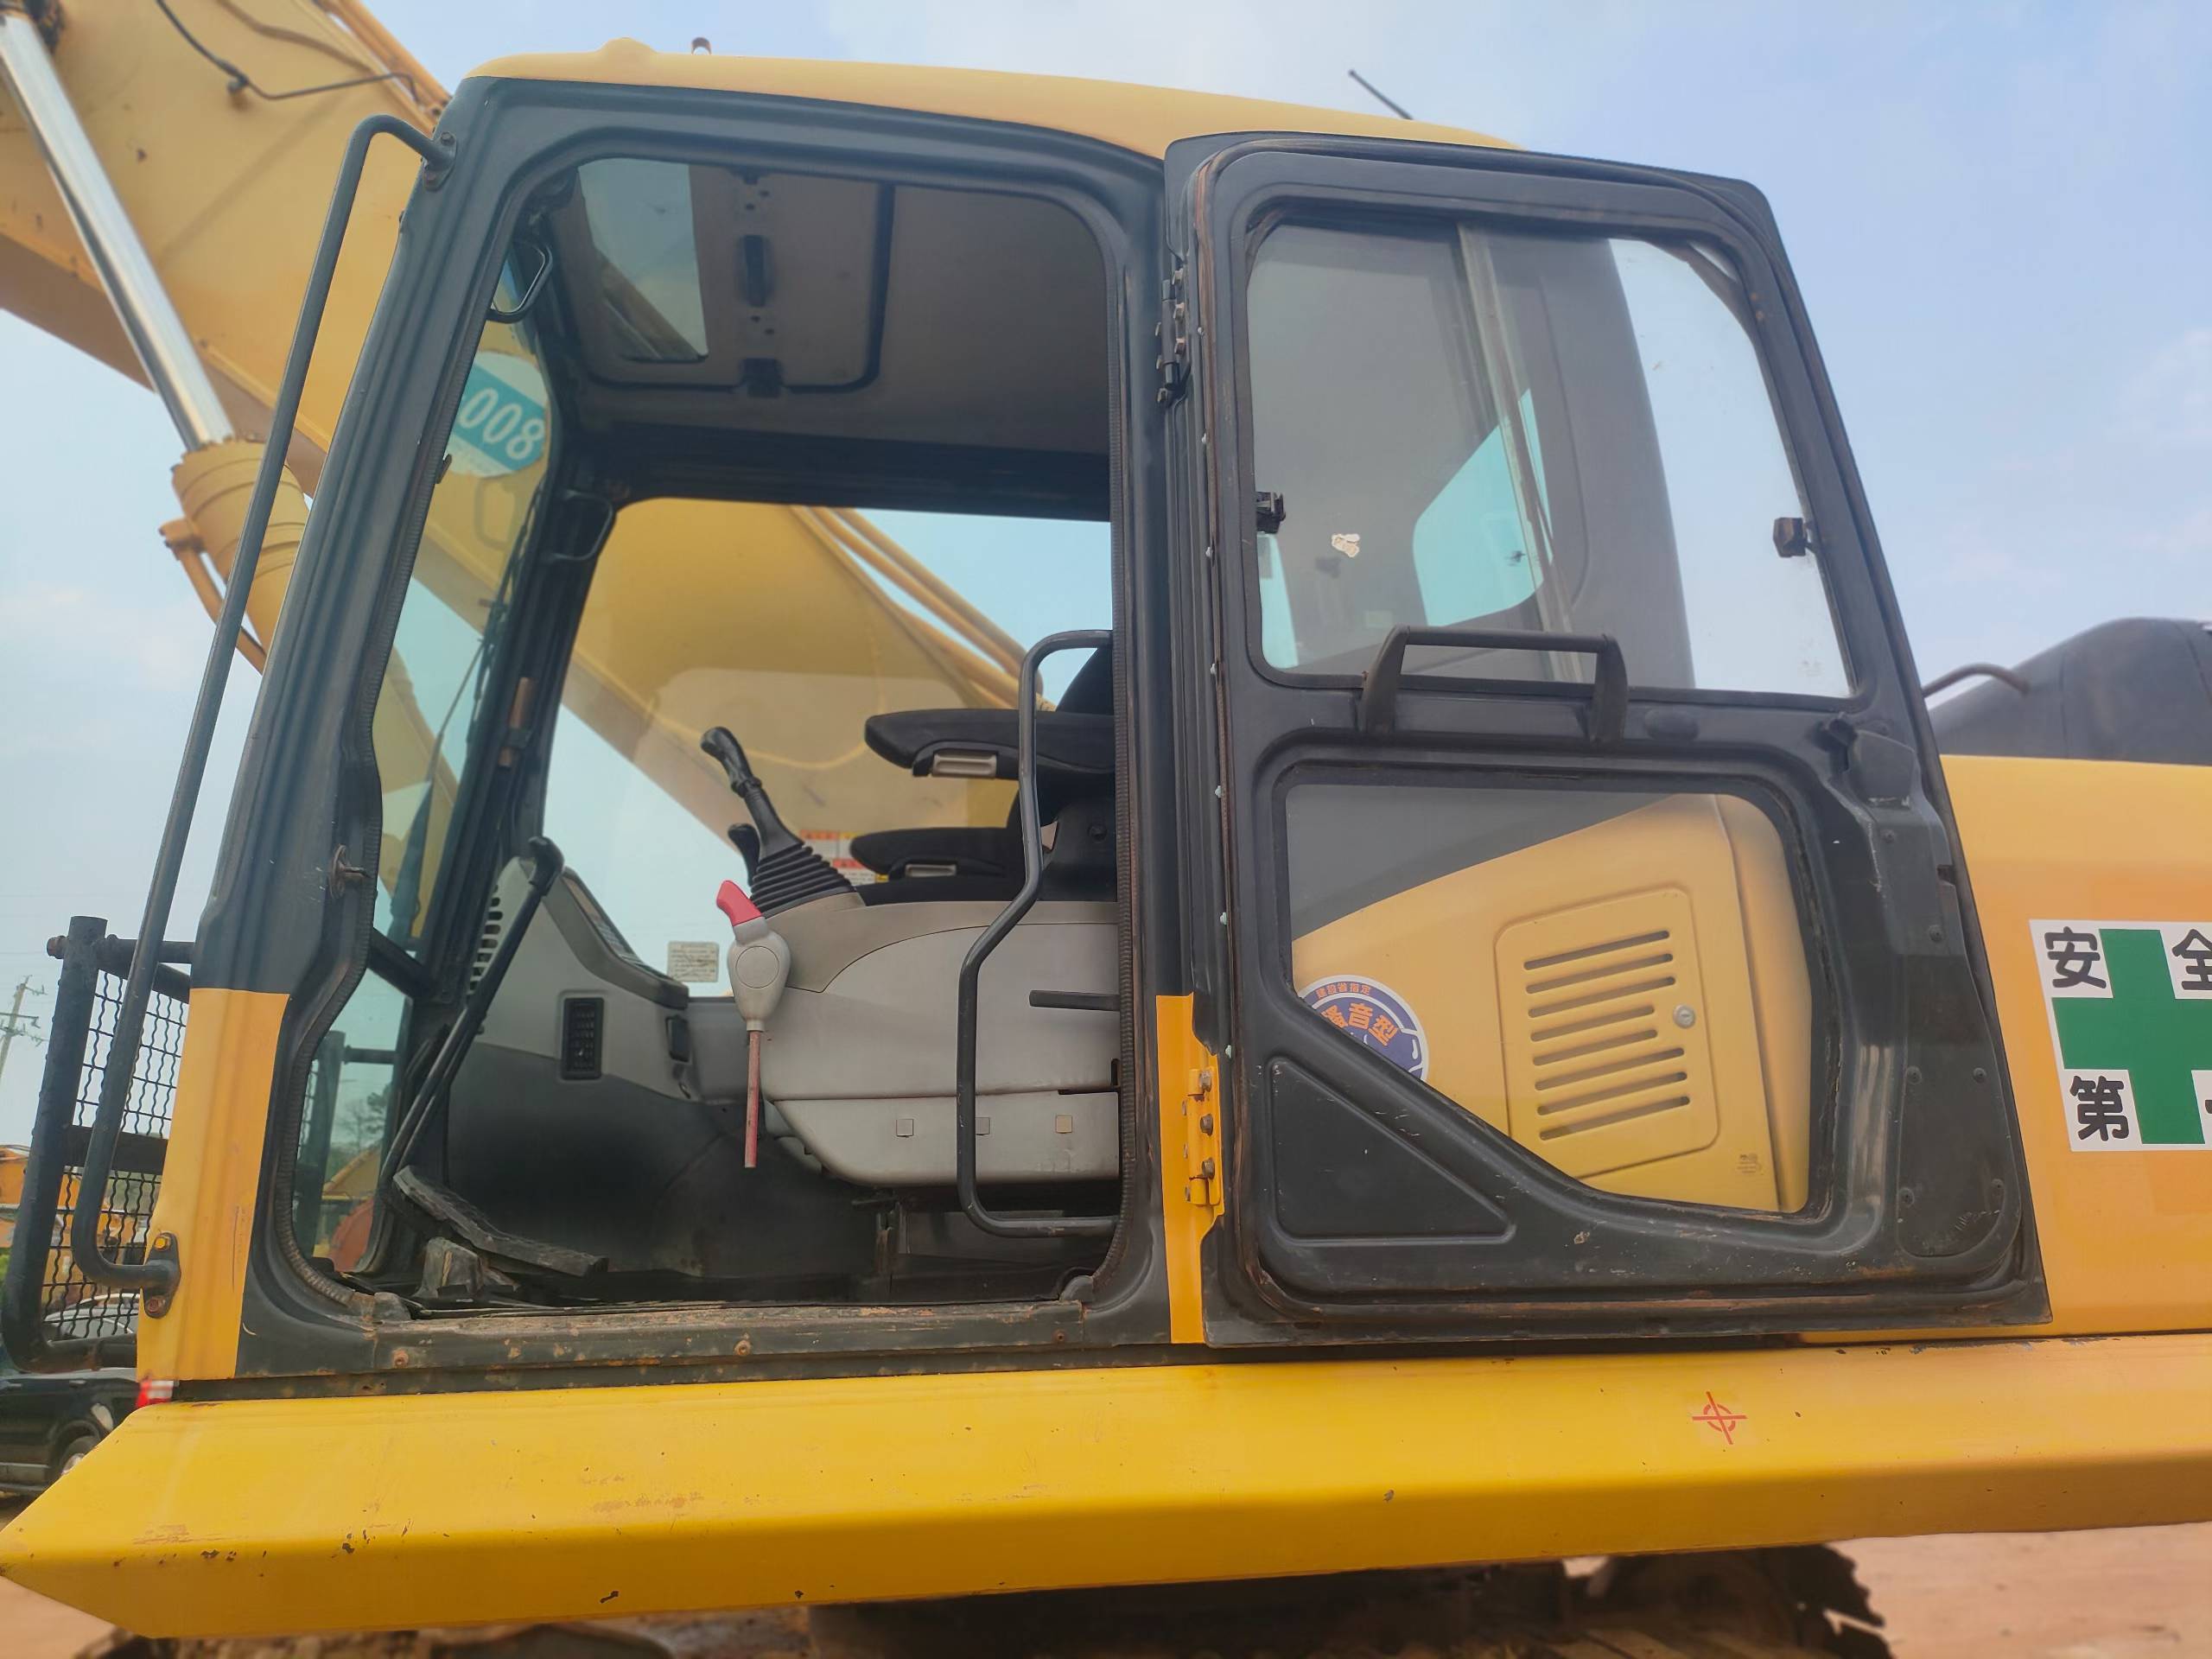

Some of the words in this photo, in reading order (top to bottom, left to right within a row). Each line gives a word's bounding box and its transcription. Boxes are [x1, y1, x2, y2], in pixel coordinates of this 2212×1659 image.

[457, 386, 545, 461] 008
[2044, 925, 2107, 989] 安
[2069, 1075, 2130, 1141] 第
